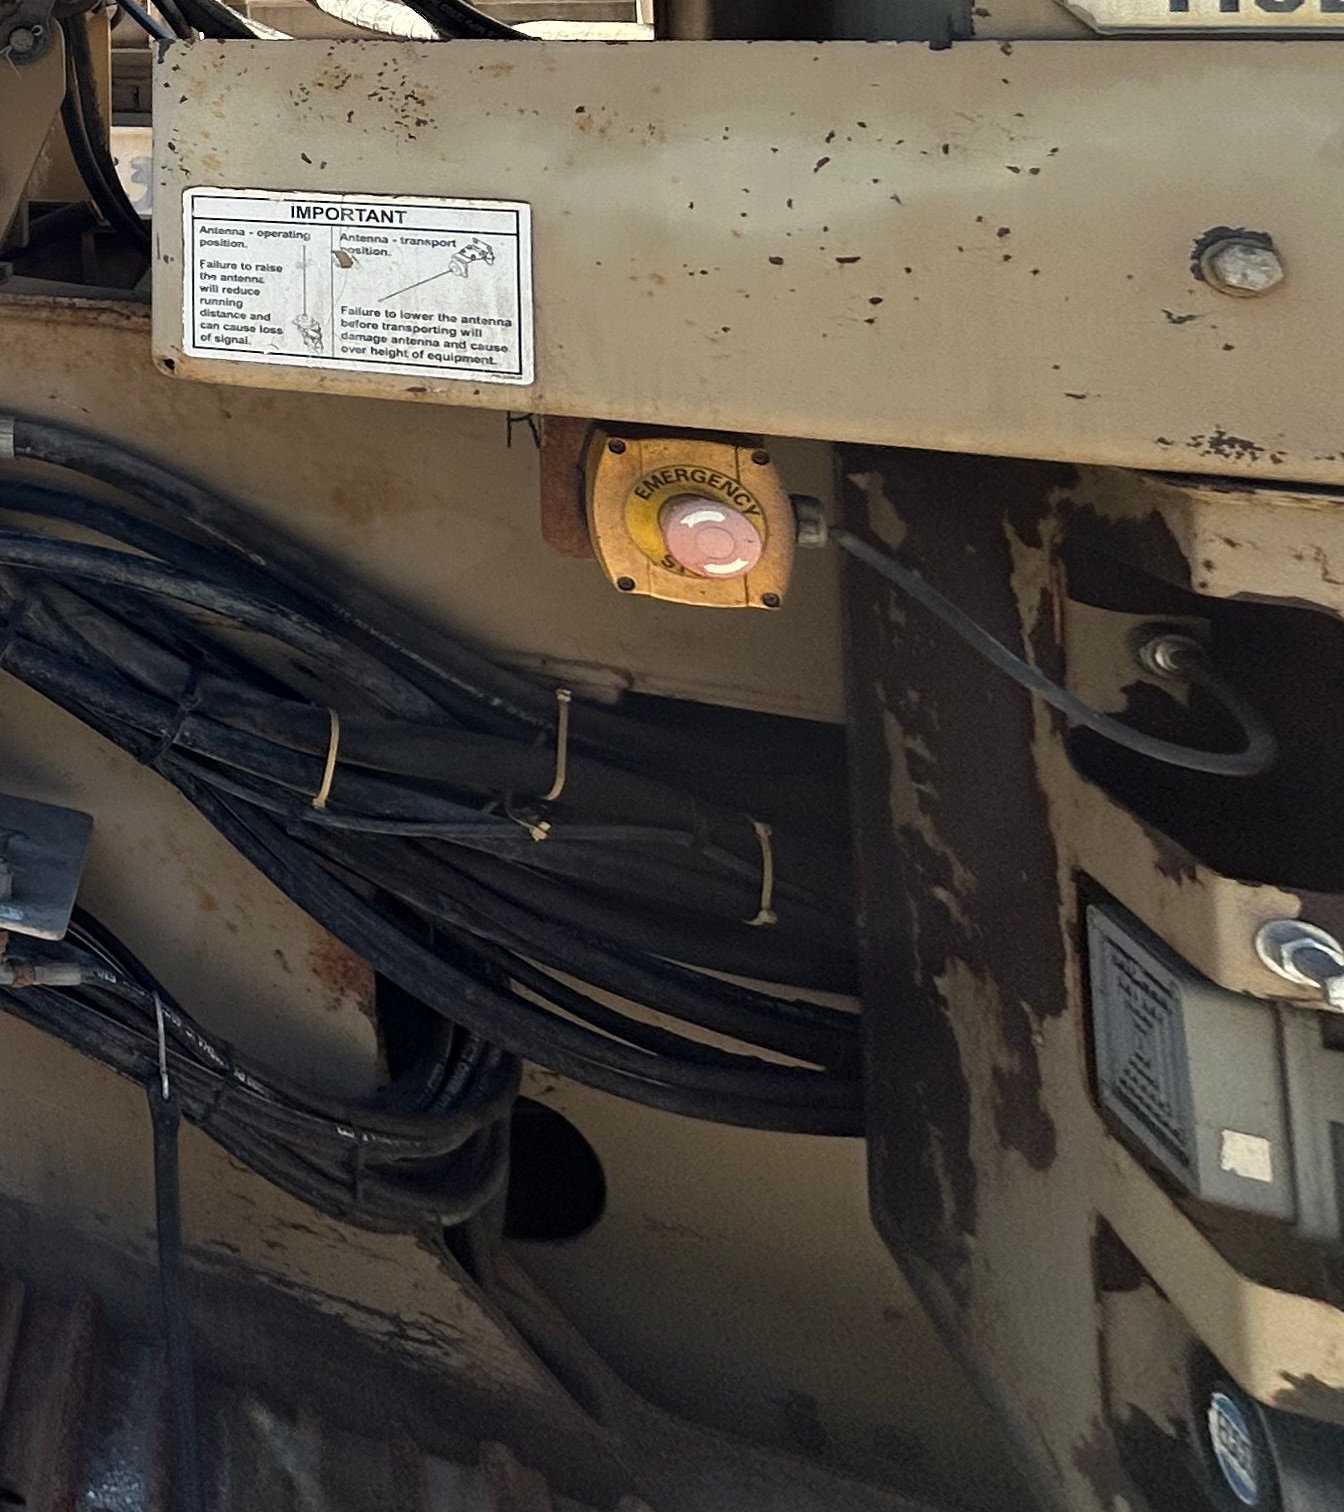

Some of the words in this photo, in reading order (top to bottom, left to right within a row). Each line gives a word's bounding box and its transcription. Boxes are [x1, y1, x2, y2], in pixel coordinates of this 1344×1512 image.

[290, 204, 407, 224] IMPORTANT
[199, 225, 246, 237] Antenna
[256, 229, 311, 242] operating
[340, 233, 389, 244] Antenna
[400, 236, 457, 248] transport
[199, 239, 248, 249] position.
[199, 259, 238, 270] Failure
[240, 262, 253, 271] to
[255, 263, 283, 273] raise
[199, 272, 217, 281] the
[220, 274, 265, 284] antenna
[199, 285, 219, 294] will
[221, 286, 261, 296] reduce
[199, 297, 244, 309] running
[199, 309, 247, 320] distance
[249, 312, 271, 322] and
[340, 305, 381, 318] Failure
[384, 309, 397, 319] to
[400, 310, 435, 322] lower
[437, 313, 458, 324] the
[461, 315, 513, 328] antenna
[200, 322, 220, 331] can
[223, 323, 257, 333] cause
[259, 325, 284, 335] loss
[340, 318, 379, 330] before
[381, 321, 457, 338] transporting
[460, 327, 483, 338] will
[200, 333, 212, 342] of
[340, 332, 388, 345] damage
[390, 335, 441, 348] antenna
[443, 339, 467, 351] and
[470, 342, 509, 353] cause
[341, 345, 367, 355] over
[370, 345, 410, 360] height
[411, 349, 424, 360] of
[427, 351, 498, 366] equipment.
[633, 467, 761, 517] EMERGENCY
